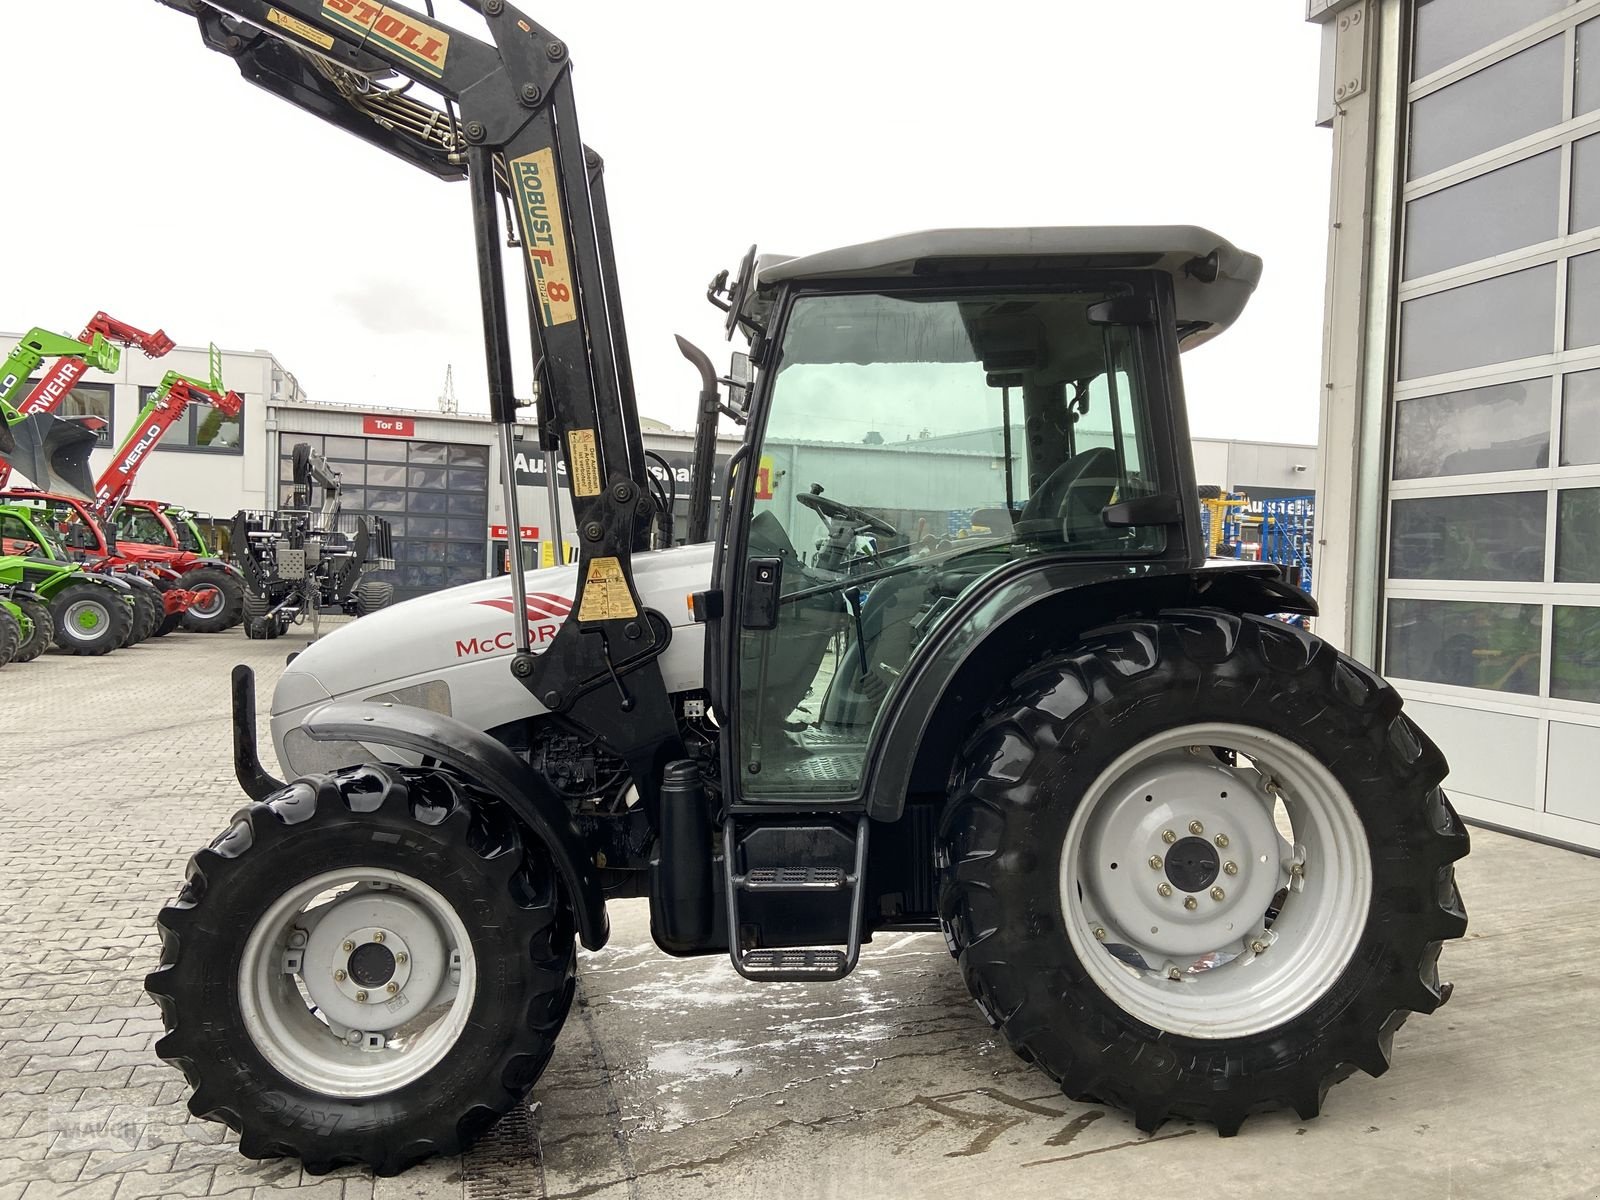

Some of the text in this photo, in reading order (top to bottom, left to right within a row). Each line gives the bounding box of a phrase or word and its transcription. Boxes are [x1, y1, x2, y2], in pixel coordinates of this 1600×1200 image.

[326, 0, 443, 62] STOLL
[520, 161, 570, 303] ROBUST F 8
[26, 362, 80, 414] RWEHR
[118, 424, 161, 475] MERLO
[375, 420, 404, 431] Tor B
